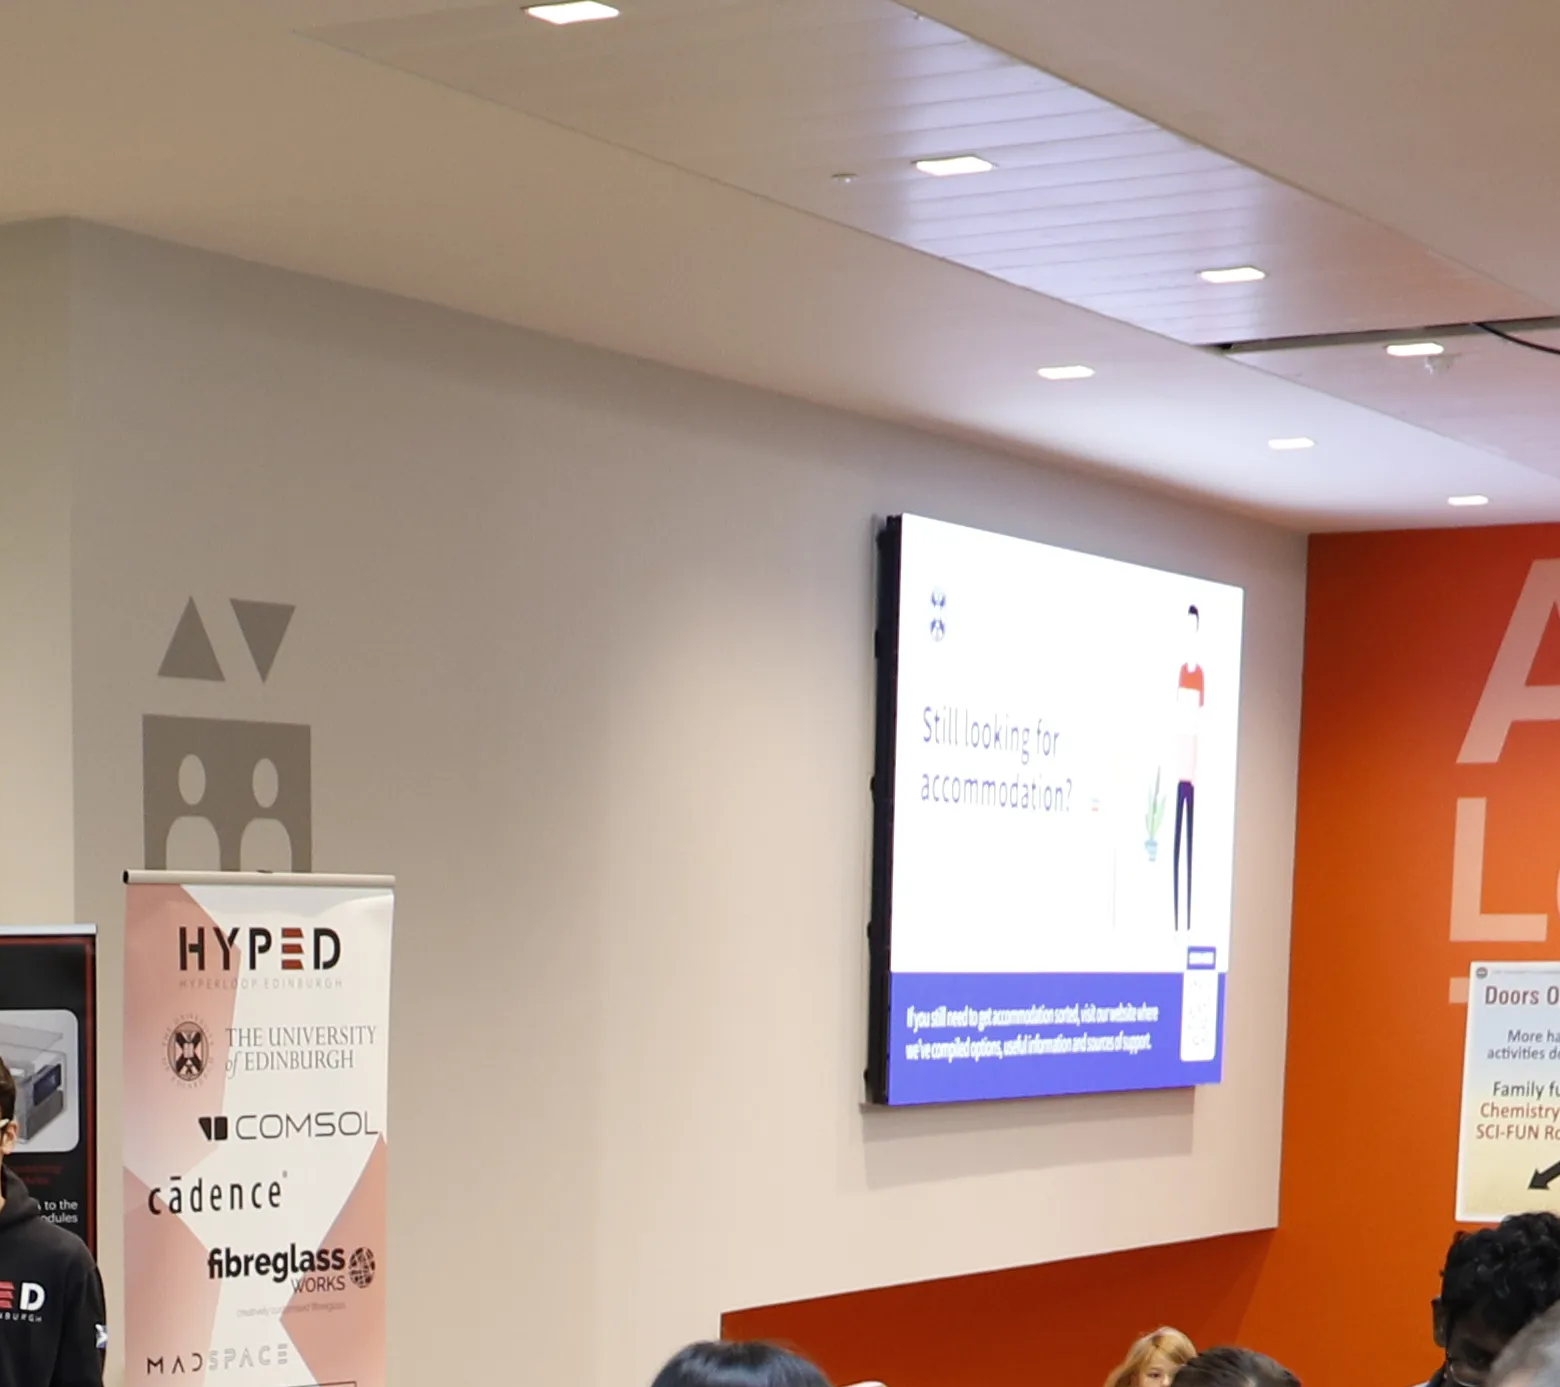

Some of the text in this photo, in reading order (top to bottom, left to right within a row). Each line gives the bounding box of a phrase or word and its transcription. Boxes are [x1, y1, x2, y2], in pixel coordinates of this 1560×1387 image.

[921, 705, 1061, 765] Still looking for
[919, 768, 1073, 814] accommodation?
[178, 926, 342, 971] HYPED
[180, 977, 343, 990] HYPERLOOP EDINBURGH
[1485, 985, 1540, 1006] Doors
[225, 1024, 377, 1048] THE UNIVERSITY
[1507, 1030, 1543, 1043] More
[1487, 1046, 1545, 1060] activities
[225, 1050, 354, 1078] of EDINBURGH
[1493, 1081, 1544, 1100] Family
[1480, 1102, 1560, 1122] Chemistry
[236, 1110, 379, 1140] COMSOL
[1476, 1123, 1540, 1140] SCI-FUN
[208, 1243, 346, 1283] fibreglass
[291, 1275, 346, 1294] WORKS
